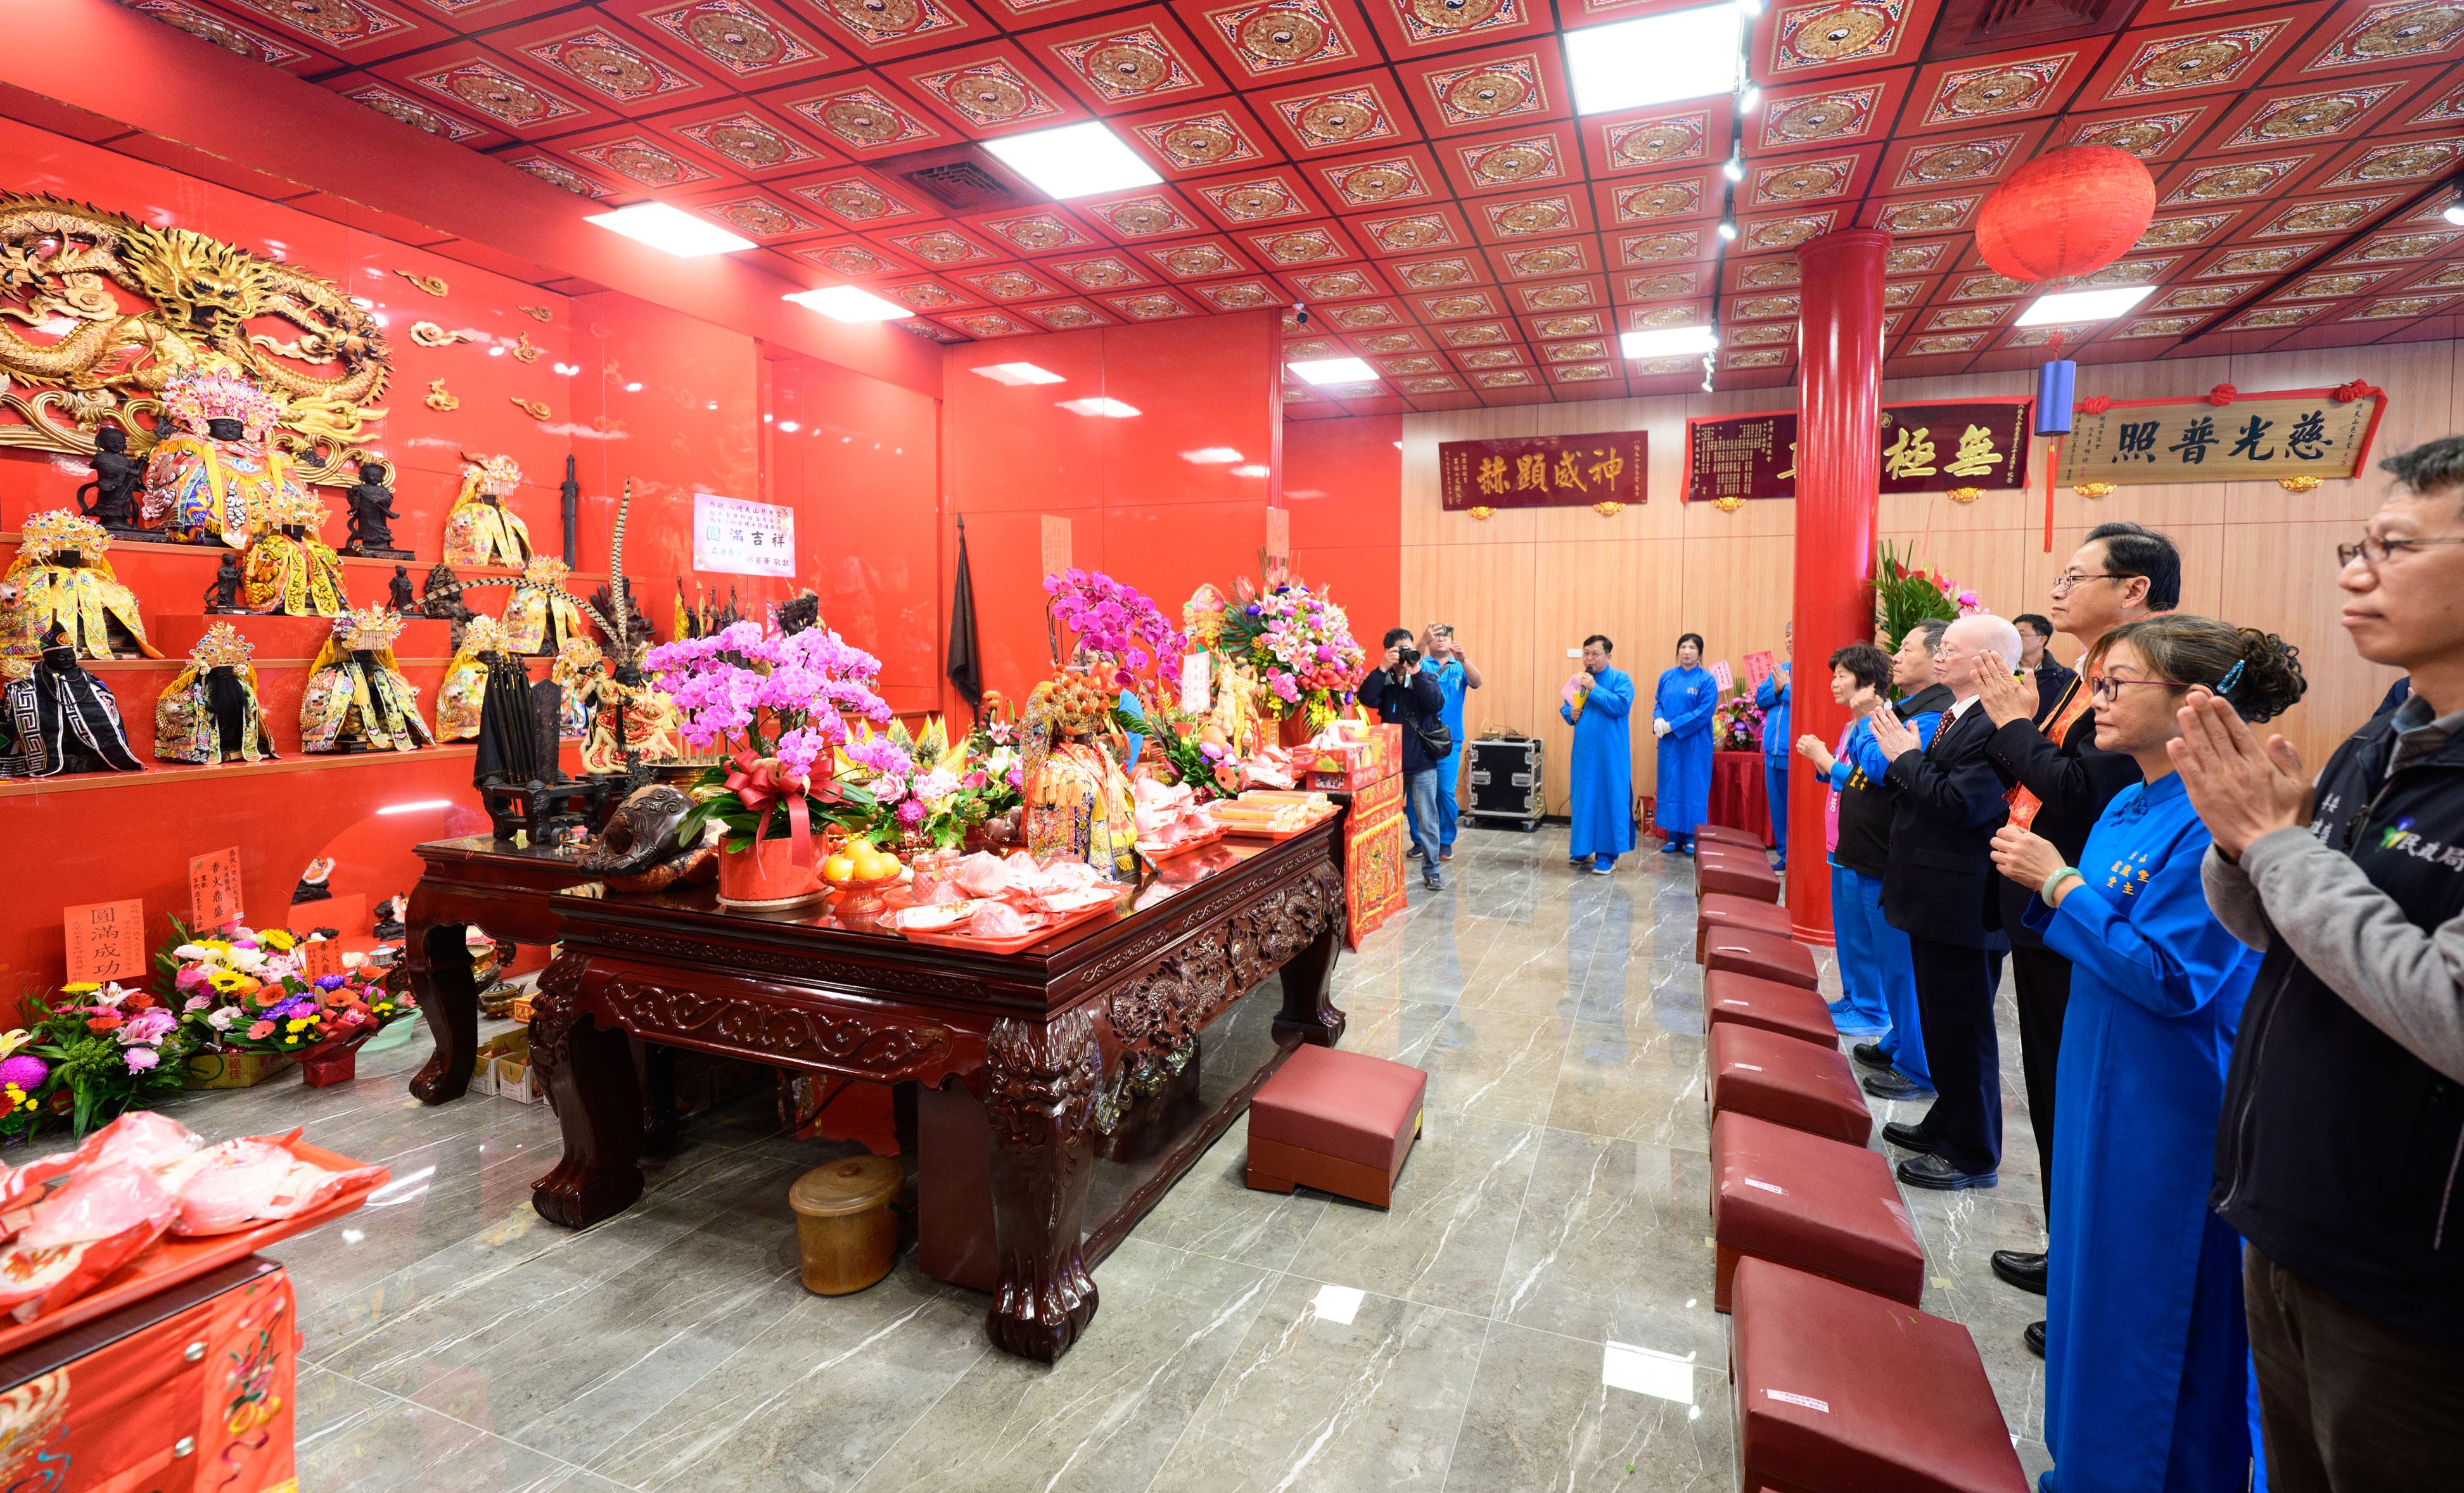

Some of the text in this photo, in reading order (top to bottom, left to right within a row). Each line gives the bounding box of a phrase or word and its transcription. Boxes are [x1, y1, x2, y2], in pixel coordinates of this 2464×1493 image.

[2112, 410, 2333, 464] 慈光普照
[1477, 447, 1624, 495] 神威顯赫
[706, 525, 785, 548] 圓滿吉祥
[212, 861, 223, 918] 香火鼎盛
[91, 907, 120, 977] 圓滿成功
